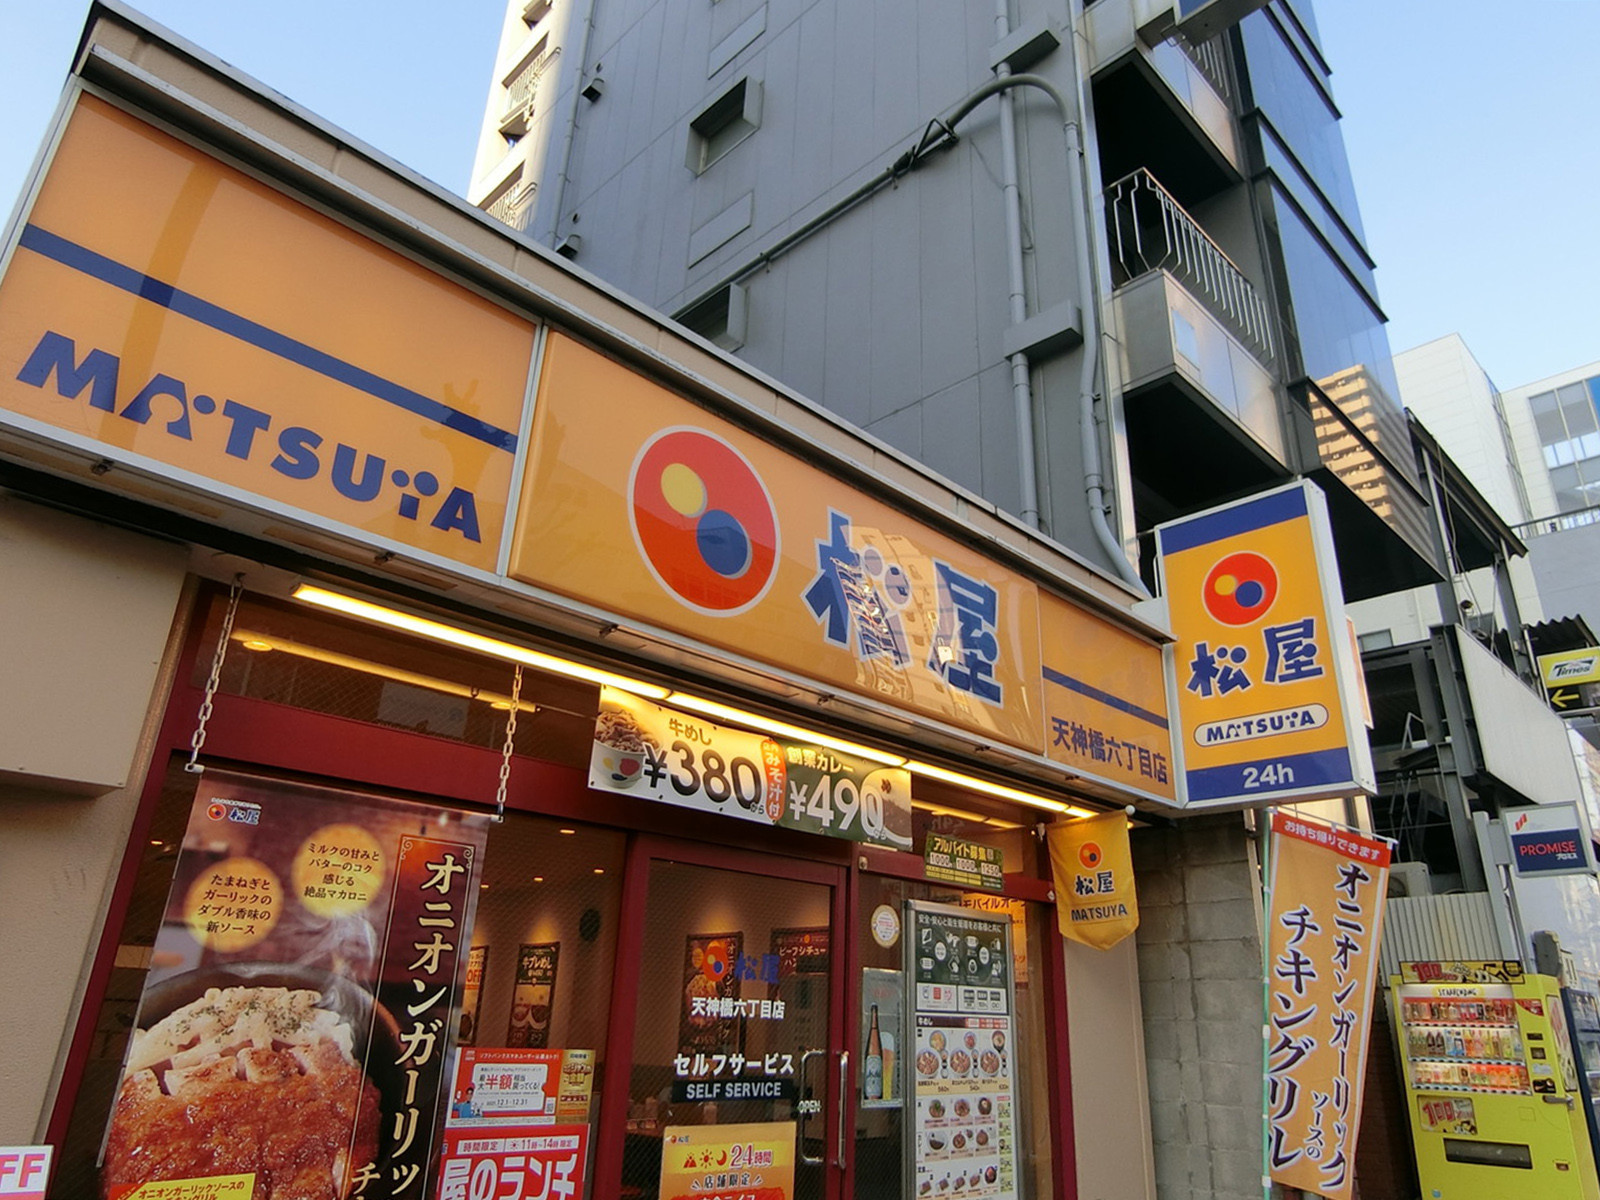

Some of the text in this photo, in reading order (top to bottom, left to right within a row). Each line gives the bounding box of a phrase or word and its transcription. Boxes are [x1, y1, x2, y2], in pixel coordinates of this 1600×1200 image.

[16, 330, 482, 543] MATSUYA
[800, 506, 1003, 708] 松屋
[1186, 617, 1324, 697] 松屋
[1553, 659, 1592, 677] Times
[669, 718, 712, 746] 牛めし
[1206, 710, 1315, 742] MATSUYA
[1051, 716, 1168, 784] 天神橋六丁目店
[786, 747, 853, 773] 創業カレー
[1242, 764, 1294, 788] 24h
[228, 808, 261, 825] 松屋
[1284, 820, 1380, 860] お持ち帰りできます
[1519, 841, 1577, 856] PROMISE
[308, 842, 380, 861] ミルクの甘みと
[309, 858, 373, 874] バターのコク
[211, 874, 271, 891] たまねぎと
[322, 874, 355, 886] 感じる
[1074, 871, 1115, 895] 松屋
[203, 889, 272, 906] ガーリックの
[304, 885, 367, 901] 絶品マカロニ
[198, 904, 271, 921] ダブル香味の
[1071, 903, 1129, 922] MATSUYA
[206, 921, 255, 935] 新ソース
[735, 951, 780, 984] 松屋
[691, 996, 786, 1019] 天神橋六丁目店
[1319, 862, 1371, 1189] オニオンガーリック
[1269, 907, 1321, 1169] チキングリル
[674, 1053, 795, 1077] セルフサービス
[485, 1073, 514, 1090] 半額
[686, 1081, 781, 1099] SELF SERVICE
[798, 1100, 822, 1113] OPEN
[1304, 1091, 1328, 1159] ソースの
[463, 1141, 499, 1153] 時間限定
[139, 1181, 245, 1199] オニオンガーリックソースの
[704, 1173, 750, 1189] 店舗限定
